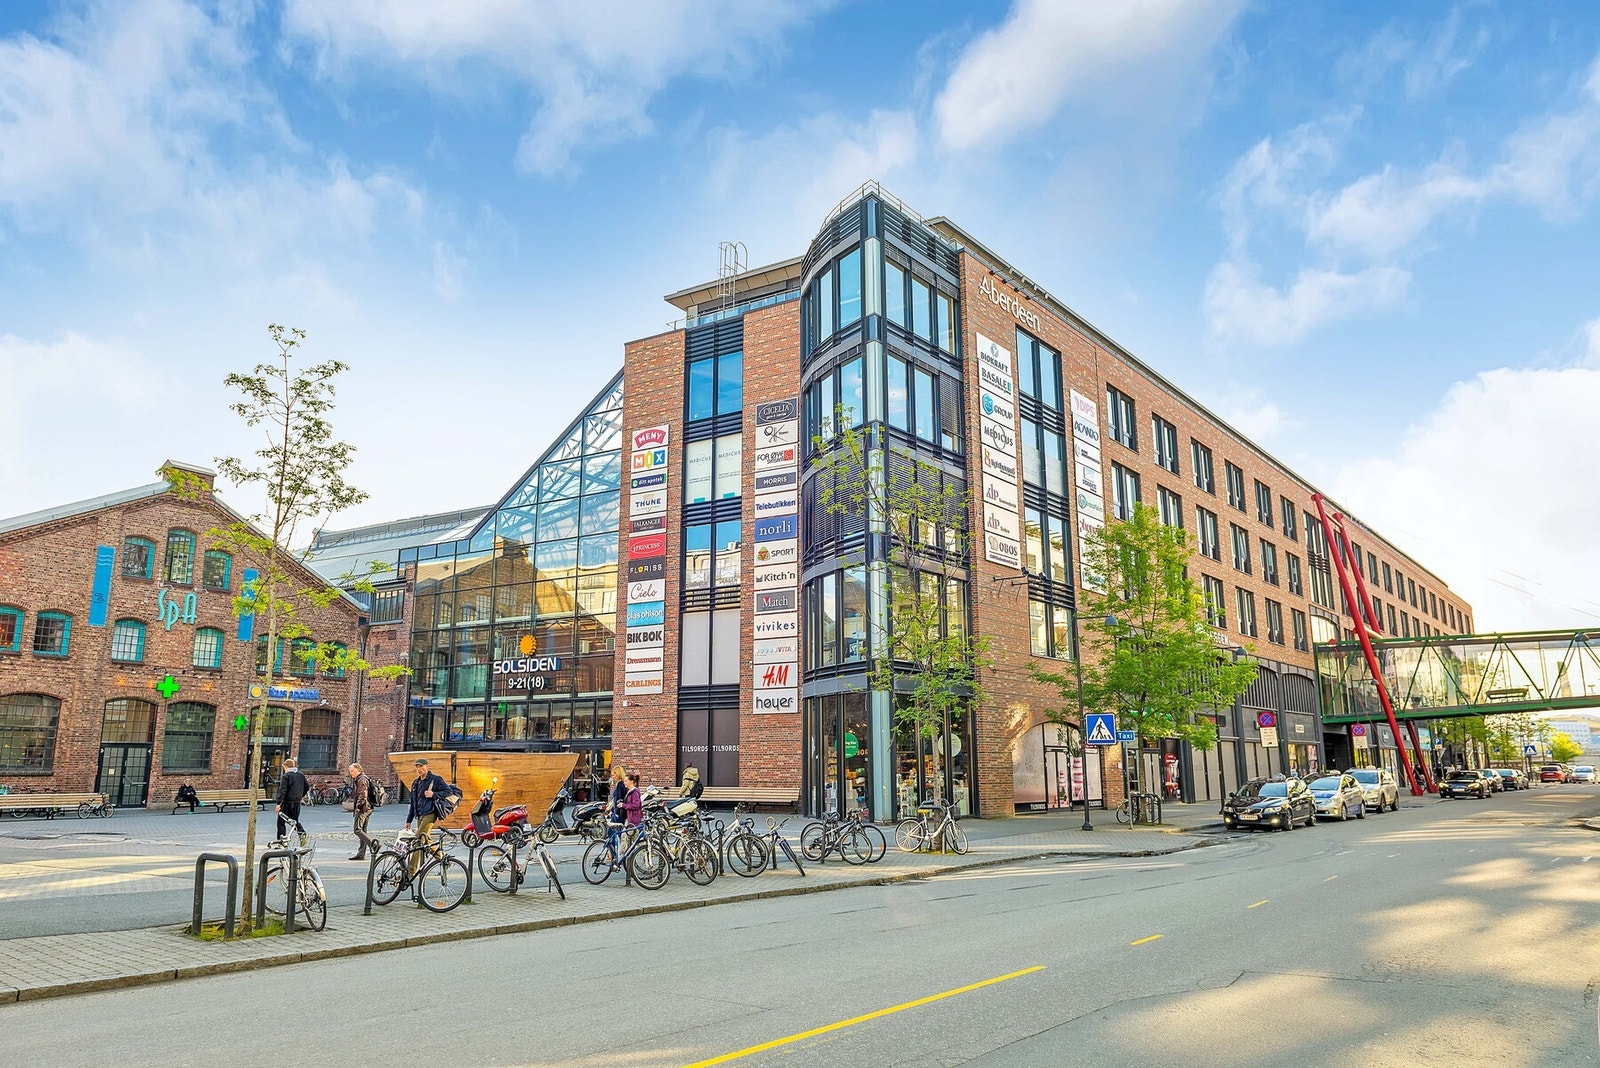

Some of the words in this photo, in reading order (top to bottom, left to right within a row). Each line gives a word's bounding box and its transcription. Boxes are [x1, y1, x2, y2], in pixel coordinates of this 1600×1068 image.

[979, 274, 1040, 333] Aberdeen
[980, 351, 1009, 373] BIOKRAFT
[994, 405, 1013, 420] GROUP
[638, 432, 662, 444] MENY
[983, 425, 1014, 447] MEDICUS
[634, 451, 665, 468] MIX
[763, 476, 788, 485] MORRIS
[635, 498, 662, 508] THUNE
[756, 500, 796, 511] Telebutikken
[760, 521, 792, 536] norli
[771, 548, 795, 557] SPORT
[999, 542, 1018, 556] OBOS
[629, 564, 662, 574] FLORISS
[631, 583, 657, 600] Cielo
[762, 595, 788, 608] Match
[641, 609, 663, 619] ohlson
[757, 621, 796, 631] vivikes
[627, 632, 642, 644] BIK
[642, 630, 662, 642] BOK
[493, 657, 557, 675] SOLSIDEN
[627, 656, 662, 665] Dressmann
[762, 664, 789, 687] H&M
[508, 675, 545, 691] 9-21(18)
[626, 680, 661, 688] CARLINGS
